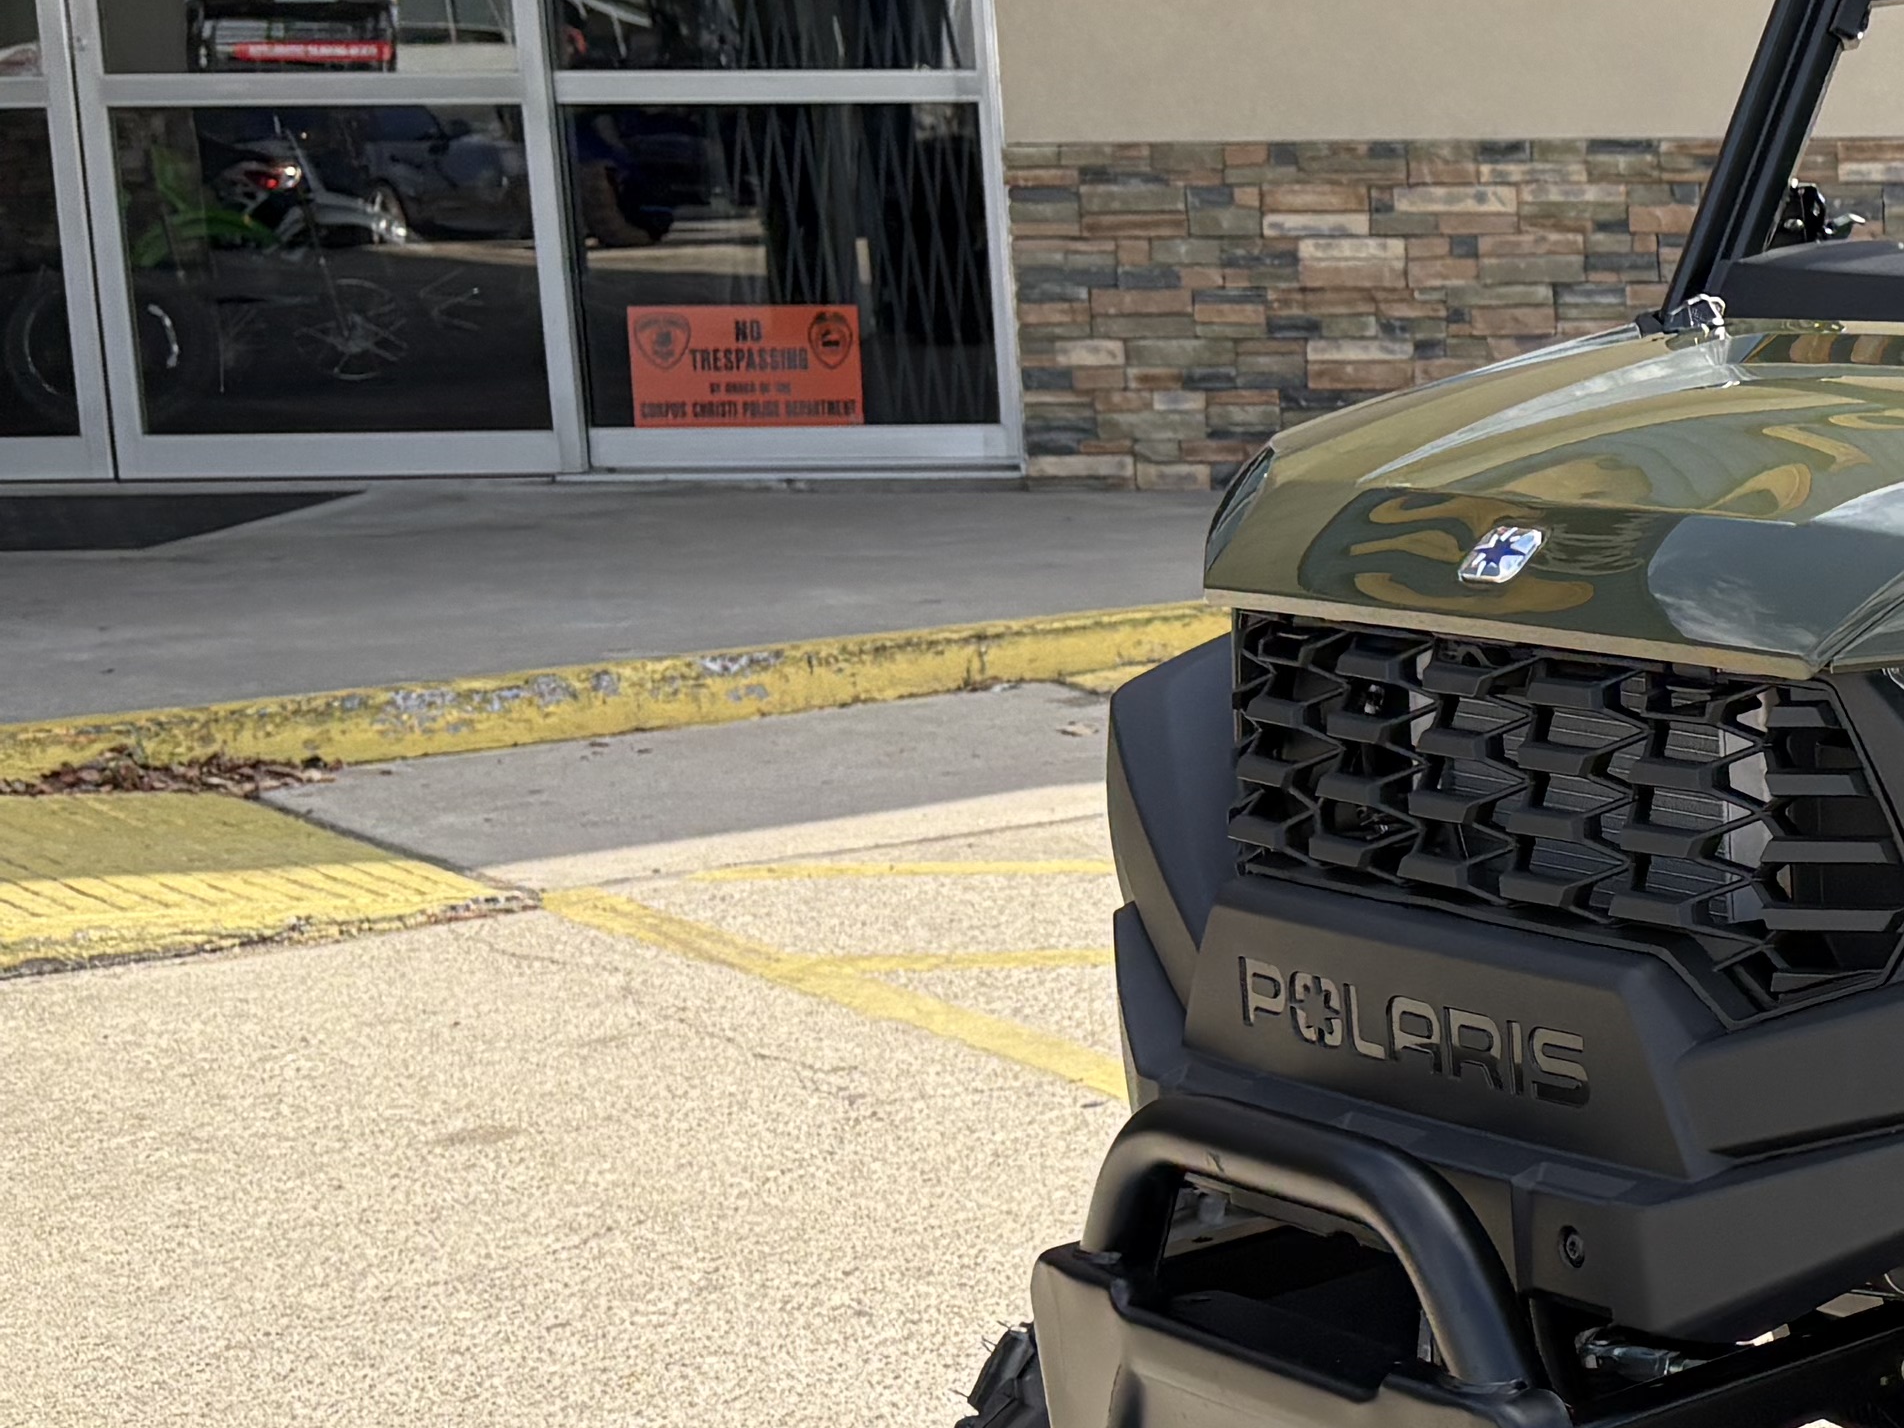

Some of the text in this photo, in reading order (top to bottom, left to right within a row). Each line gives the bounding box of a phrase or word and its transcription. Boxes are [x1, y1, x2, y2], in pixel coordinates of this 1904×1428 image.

[734, 319, 762, 343] NO
[689, 347, 808, 371] TRESPASSING
[1237, 956, 1591, 1109] POLARIS
